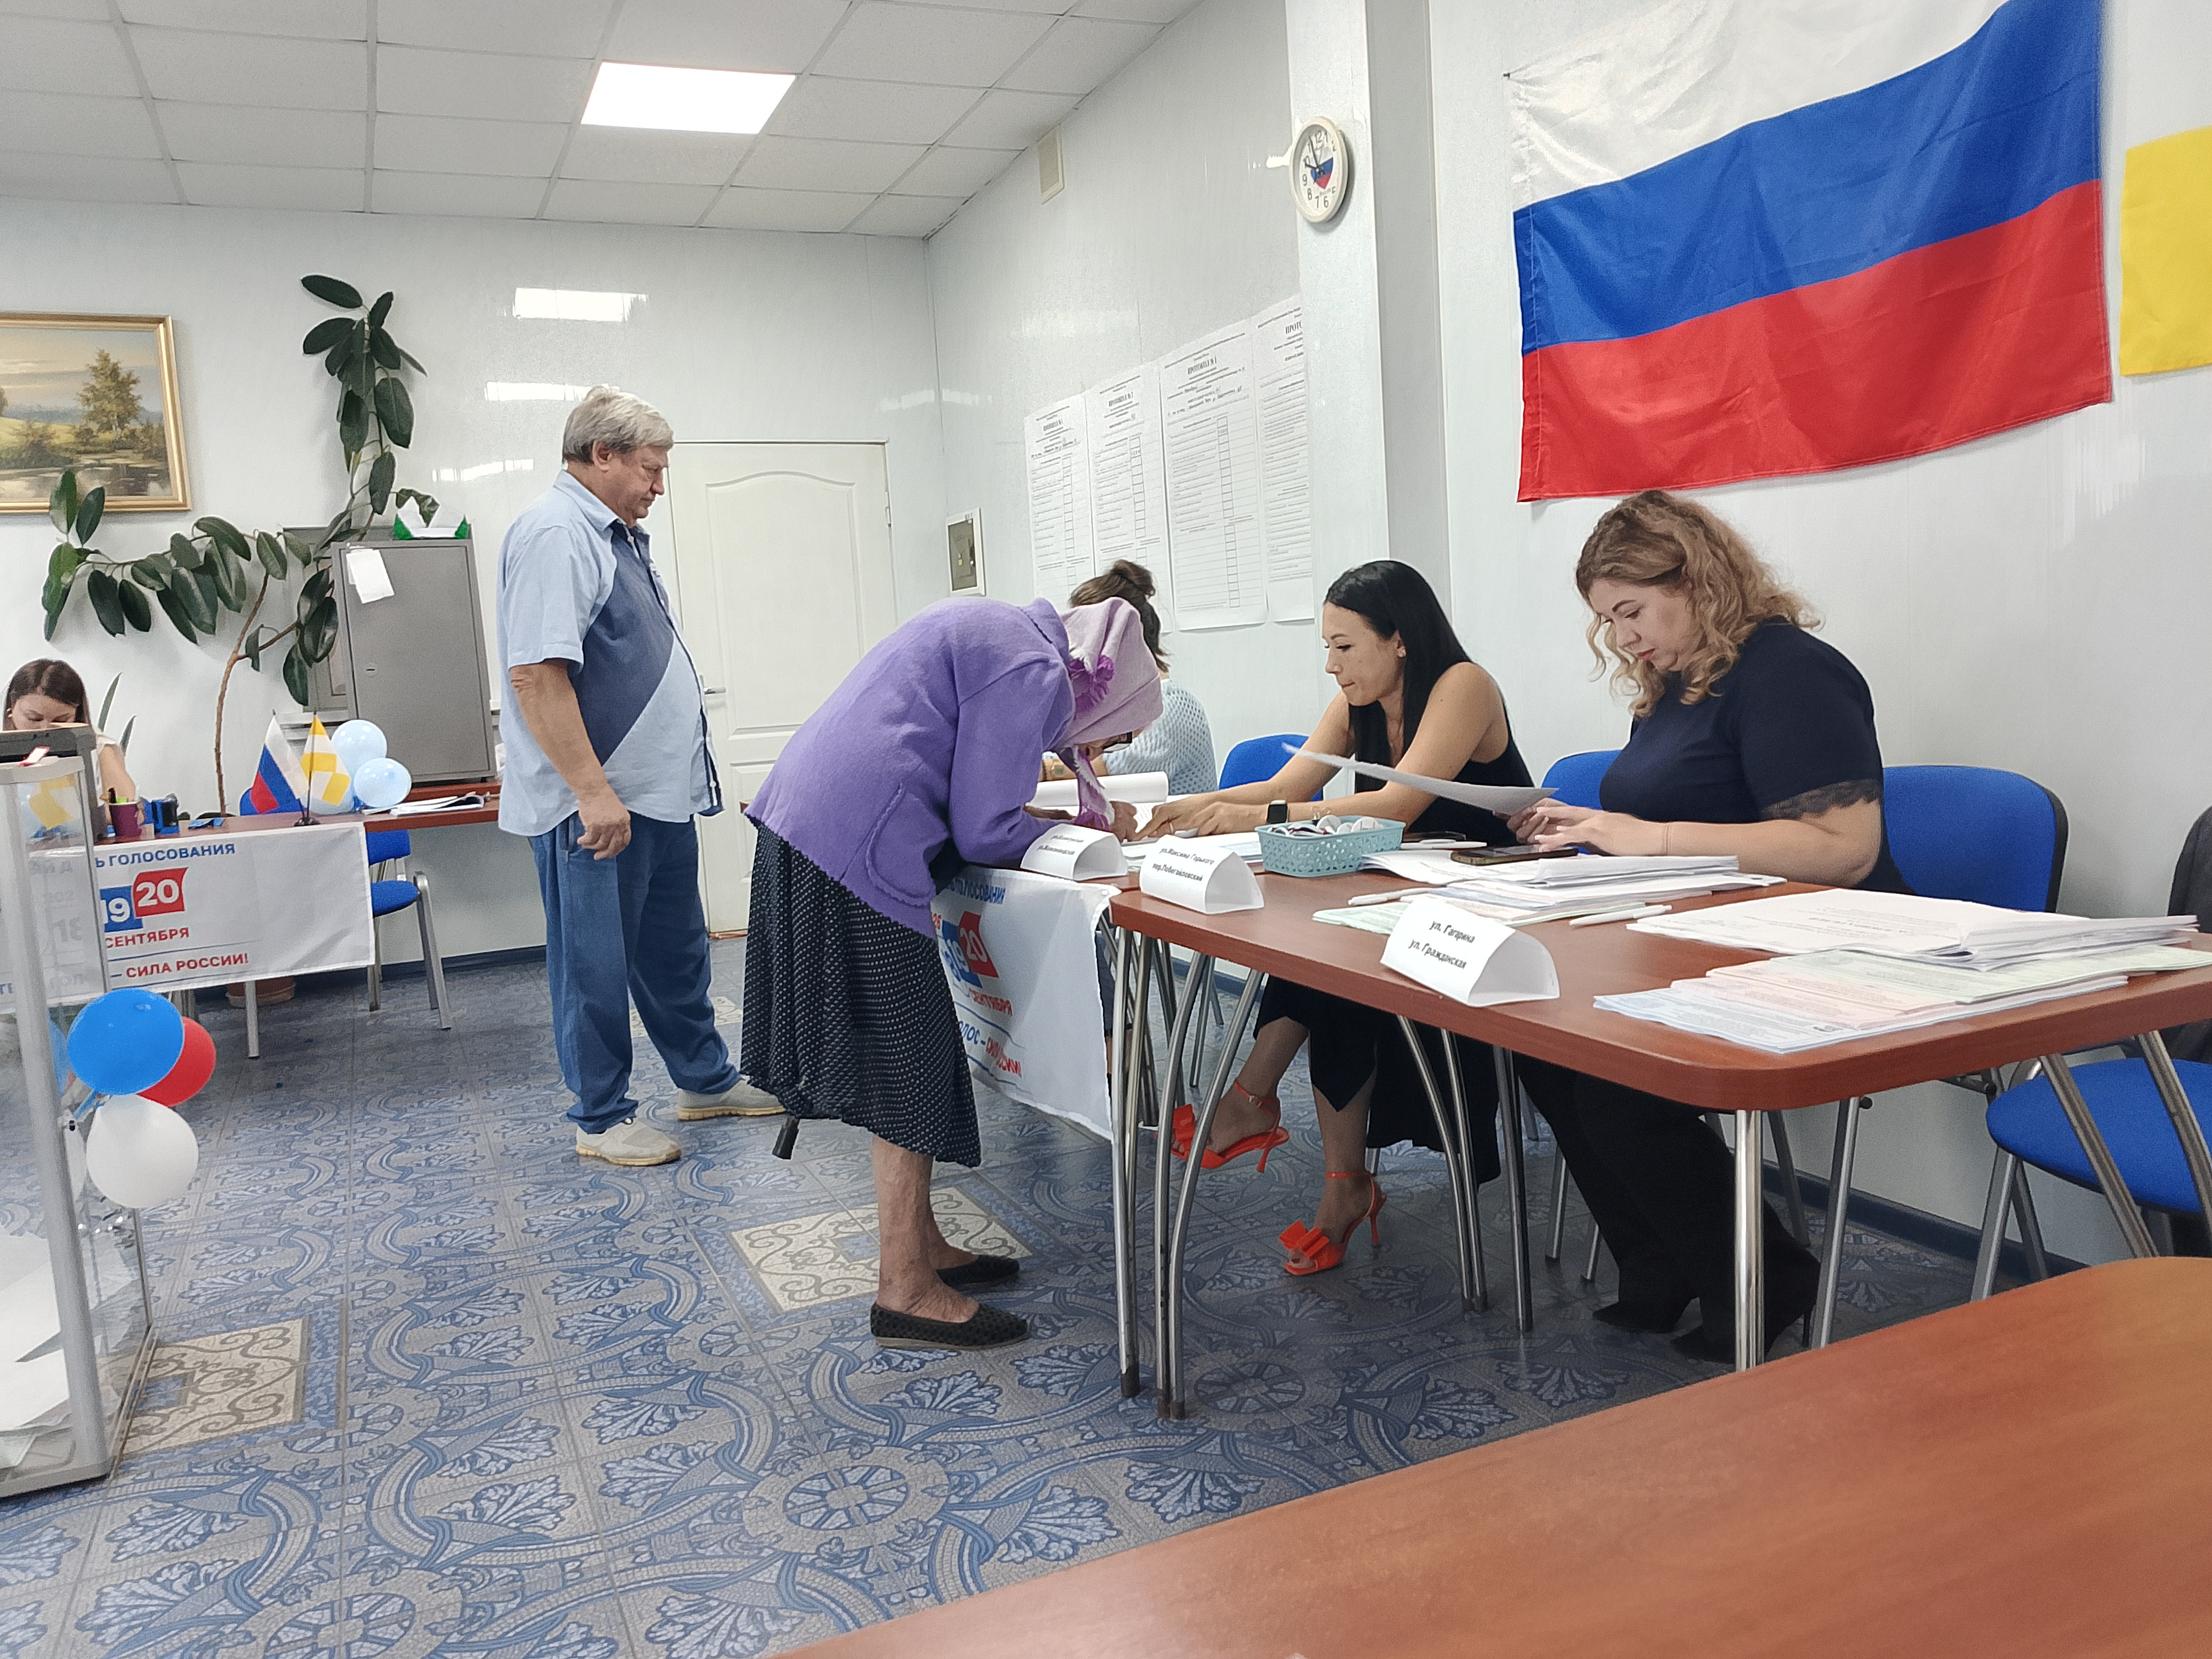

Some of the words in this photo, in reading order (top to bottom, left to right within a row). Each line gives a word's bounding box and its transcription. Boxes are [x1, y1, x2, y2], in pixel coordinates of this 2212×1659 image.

[1316, 130, 1323, 144] 12
[1302, 173, 1308, 186] 9
[1307, 187, 1312, 200] 8
[1314, 195, 1320, 208] 7
[1323, 195, 1329, 208] 6
[109, 844, 235, 867] ГОЛОСОВАНИЯ
[136, 879, 179, 908] 20
[105, 927, 190, 949] СЕНТЯБРЯ
[1428, 921, 1441, 932] ул.
[1443, 925, 1475, 943] Гагарина
[960, 927, 988, 963] 20
[1408, 939, 1420, 950] ул.
[1421, 943, 1467, 970] Гражданская
[126, 962, 172, 979] СИЛА
[176, 953, 249, 971] РОССИИ!
